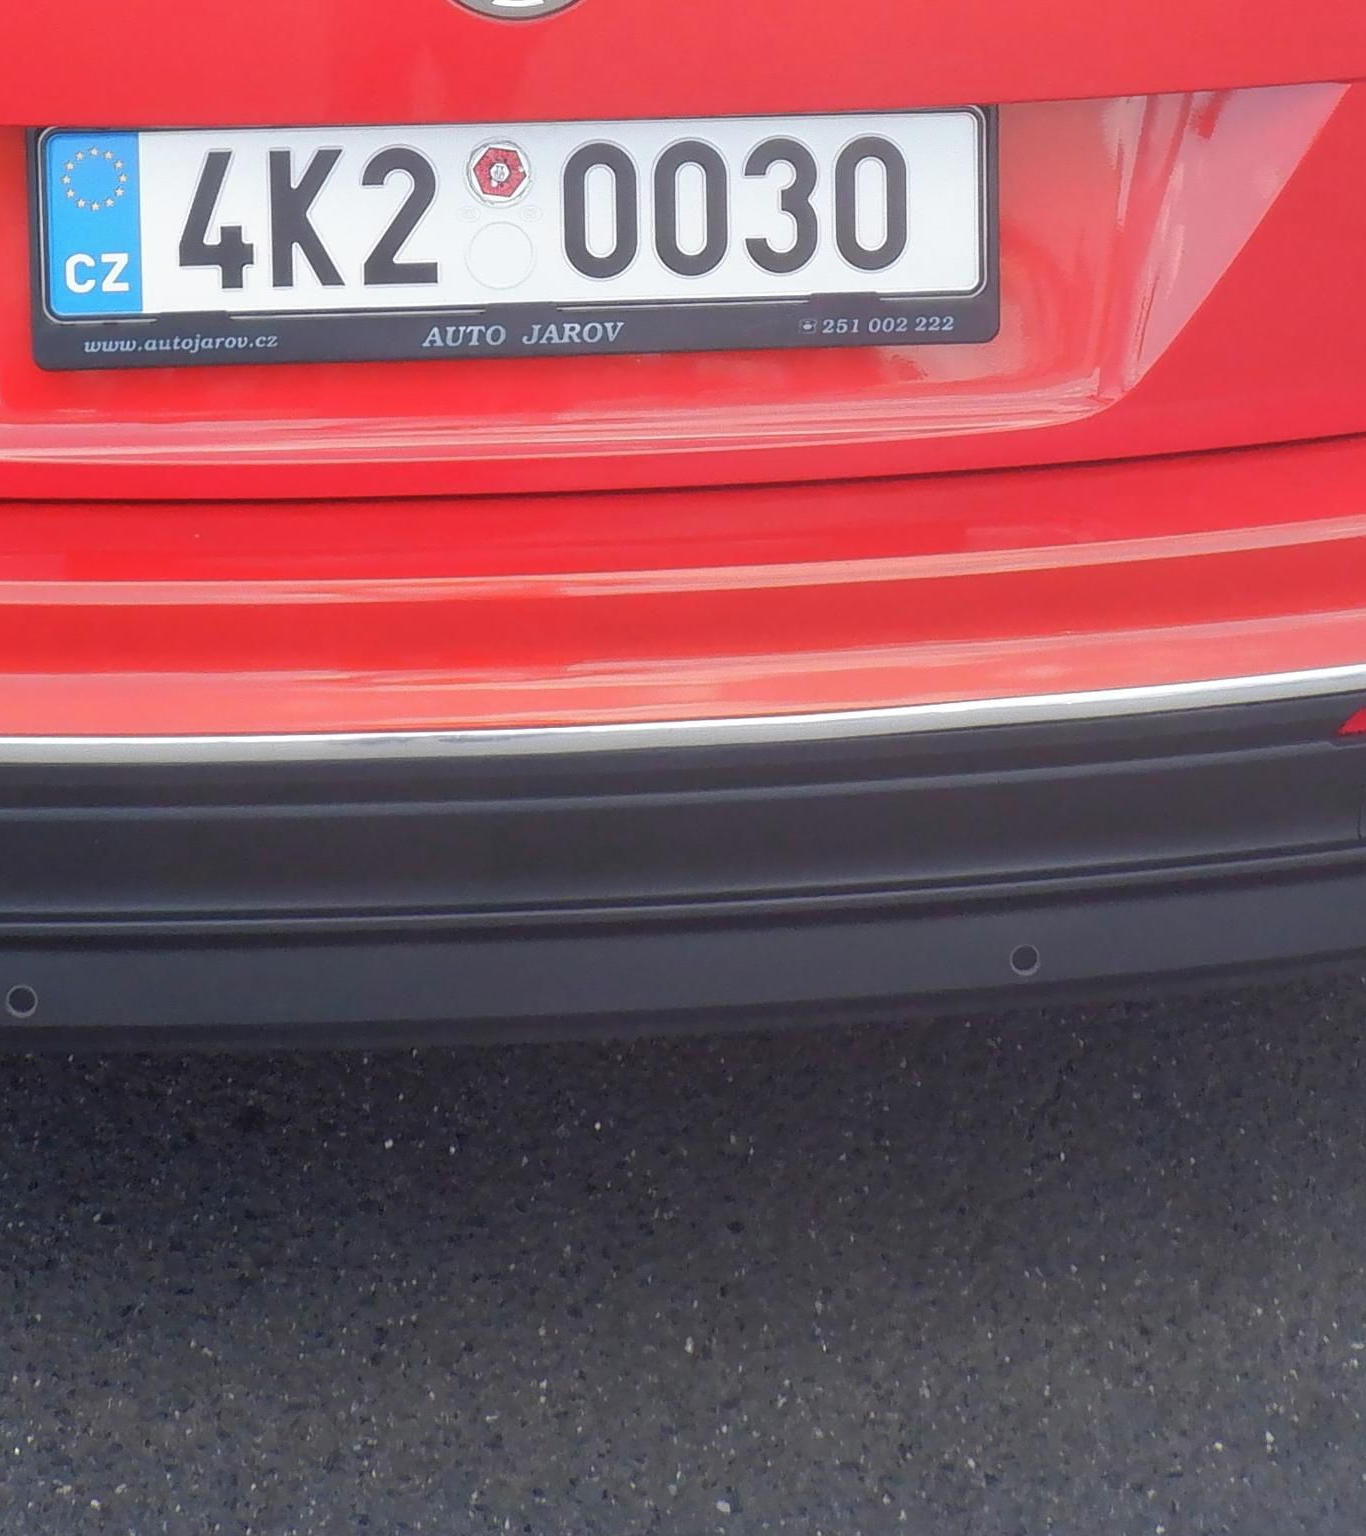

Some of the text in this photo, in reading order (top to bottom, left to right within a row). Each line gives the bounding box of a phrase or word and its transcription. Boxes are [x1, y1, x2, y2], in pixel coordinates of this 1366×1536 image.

[178, 135, 907, 289] 4K2 0030
[65, 252, 130, 293] CZ
[421, 321, 624, 348] AUTO JAROV
[822, 315, 955, 334] 251 002 222
[84, 333, 279, 354] www.autojarov.cz
